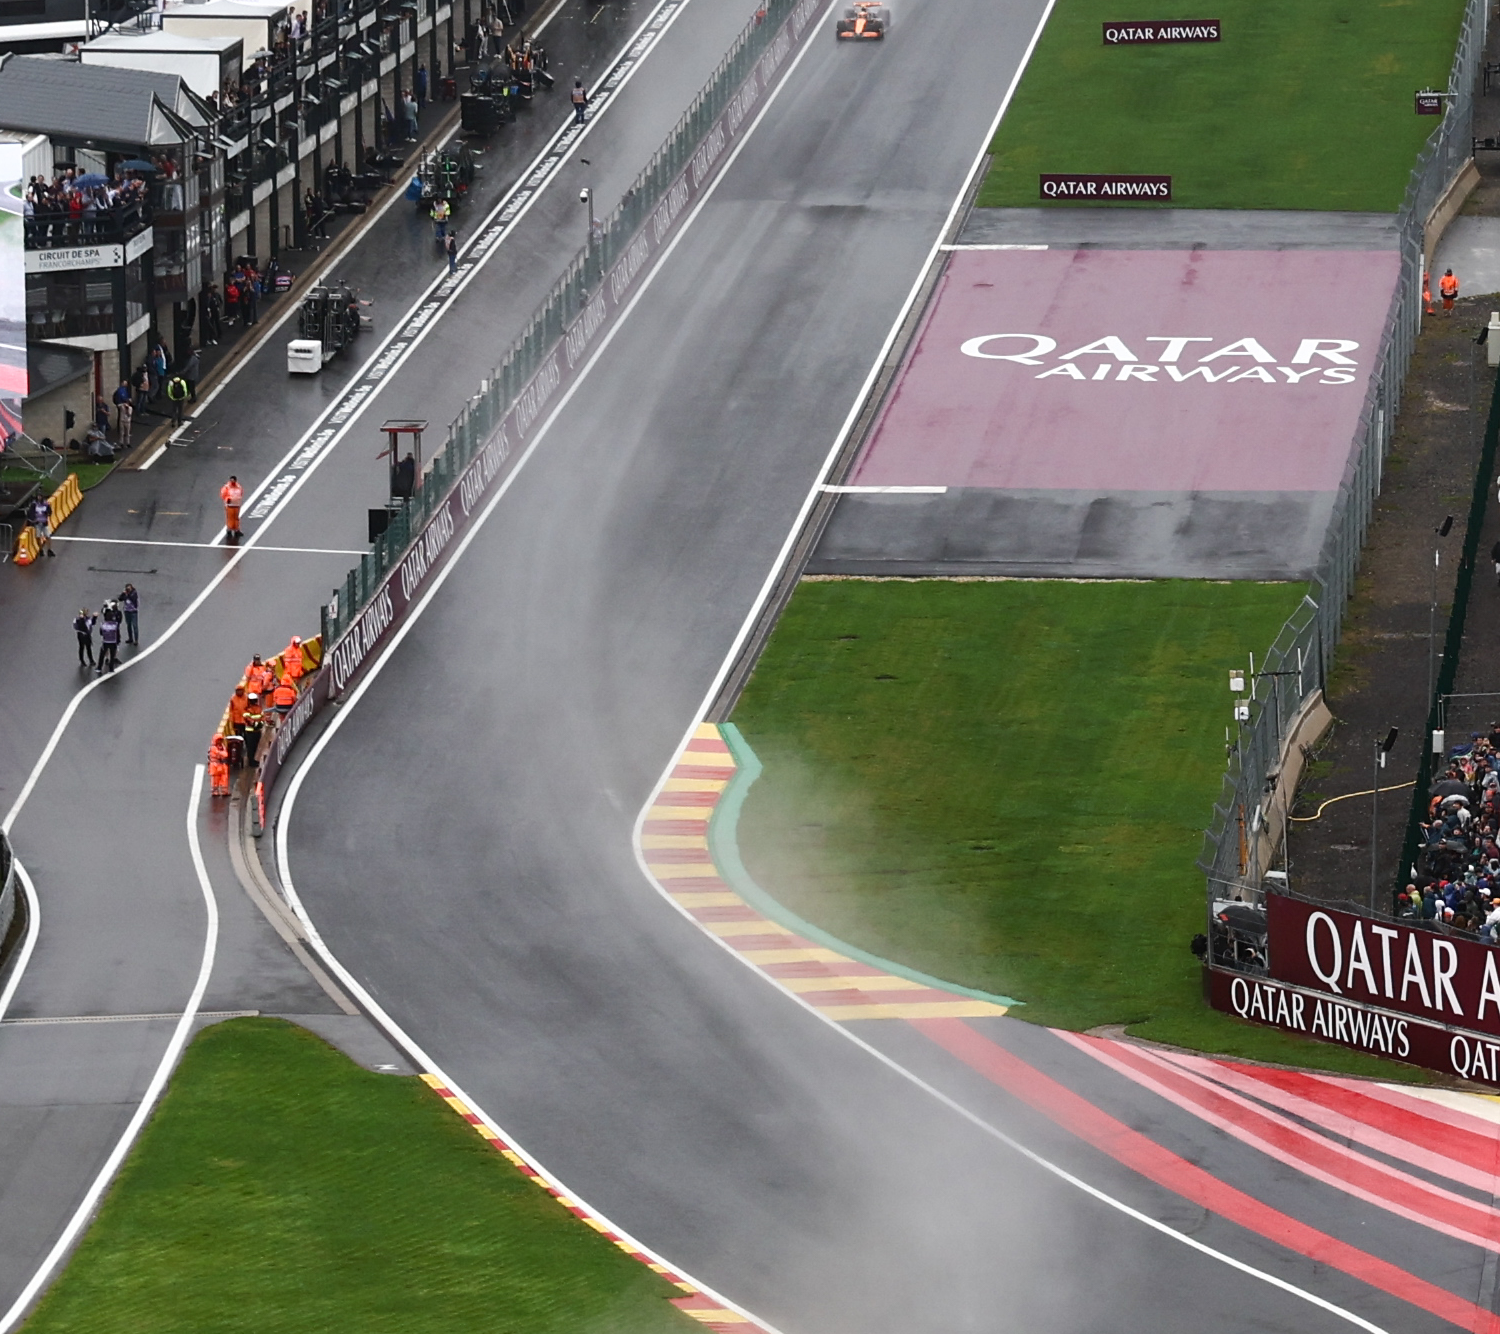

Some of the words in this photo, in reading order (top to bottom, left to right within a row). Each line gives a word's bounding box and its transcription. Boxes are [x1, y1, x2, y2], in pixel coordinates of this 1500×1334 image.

[1106, 27, 1154, 42] QATAR
[1157, 25, 1218, 40] AIRWAYS
[1043, 181, 1097, 197] QATAR
[1101, 182, 1168, 196] AIRWAYS
[39, 251, 70, 261] CIRCUIT
[72, 250, 82, 259] DE
[84, 249, 100, 258] SPA
[960, 333, 1360, 365] QATAR
[1034, 363, 1357, 384] AIRWAYS
[1306, 912, 1465, 1017] QATAR
[1230, 978, 1305, 1031] QATAR
[1312, 1000, 1411, 1058] AIRWAYS
